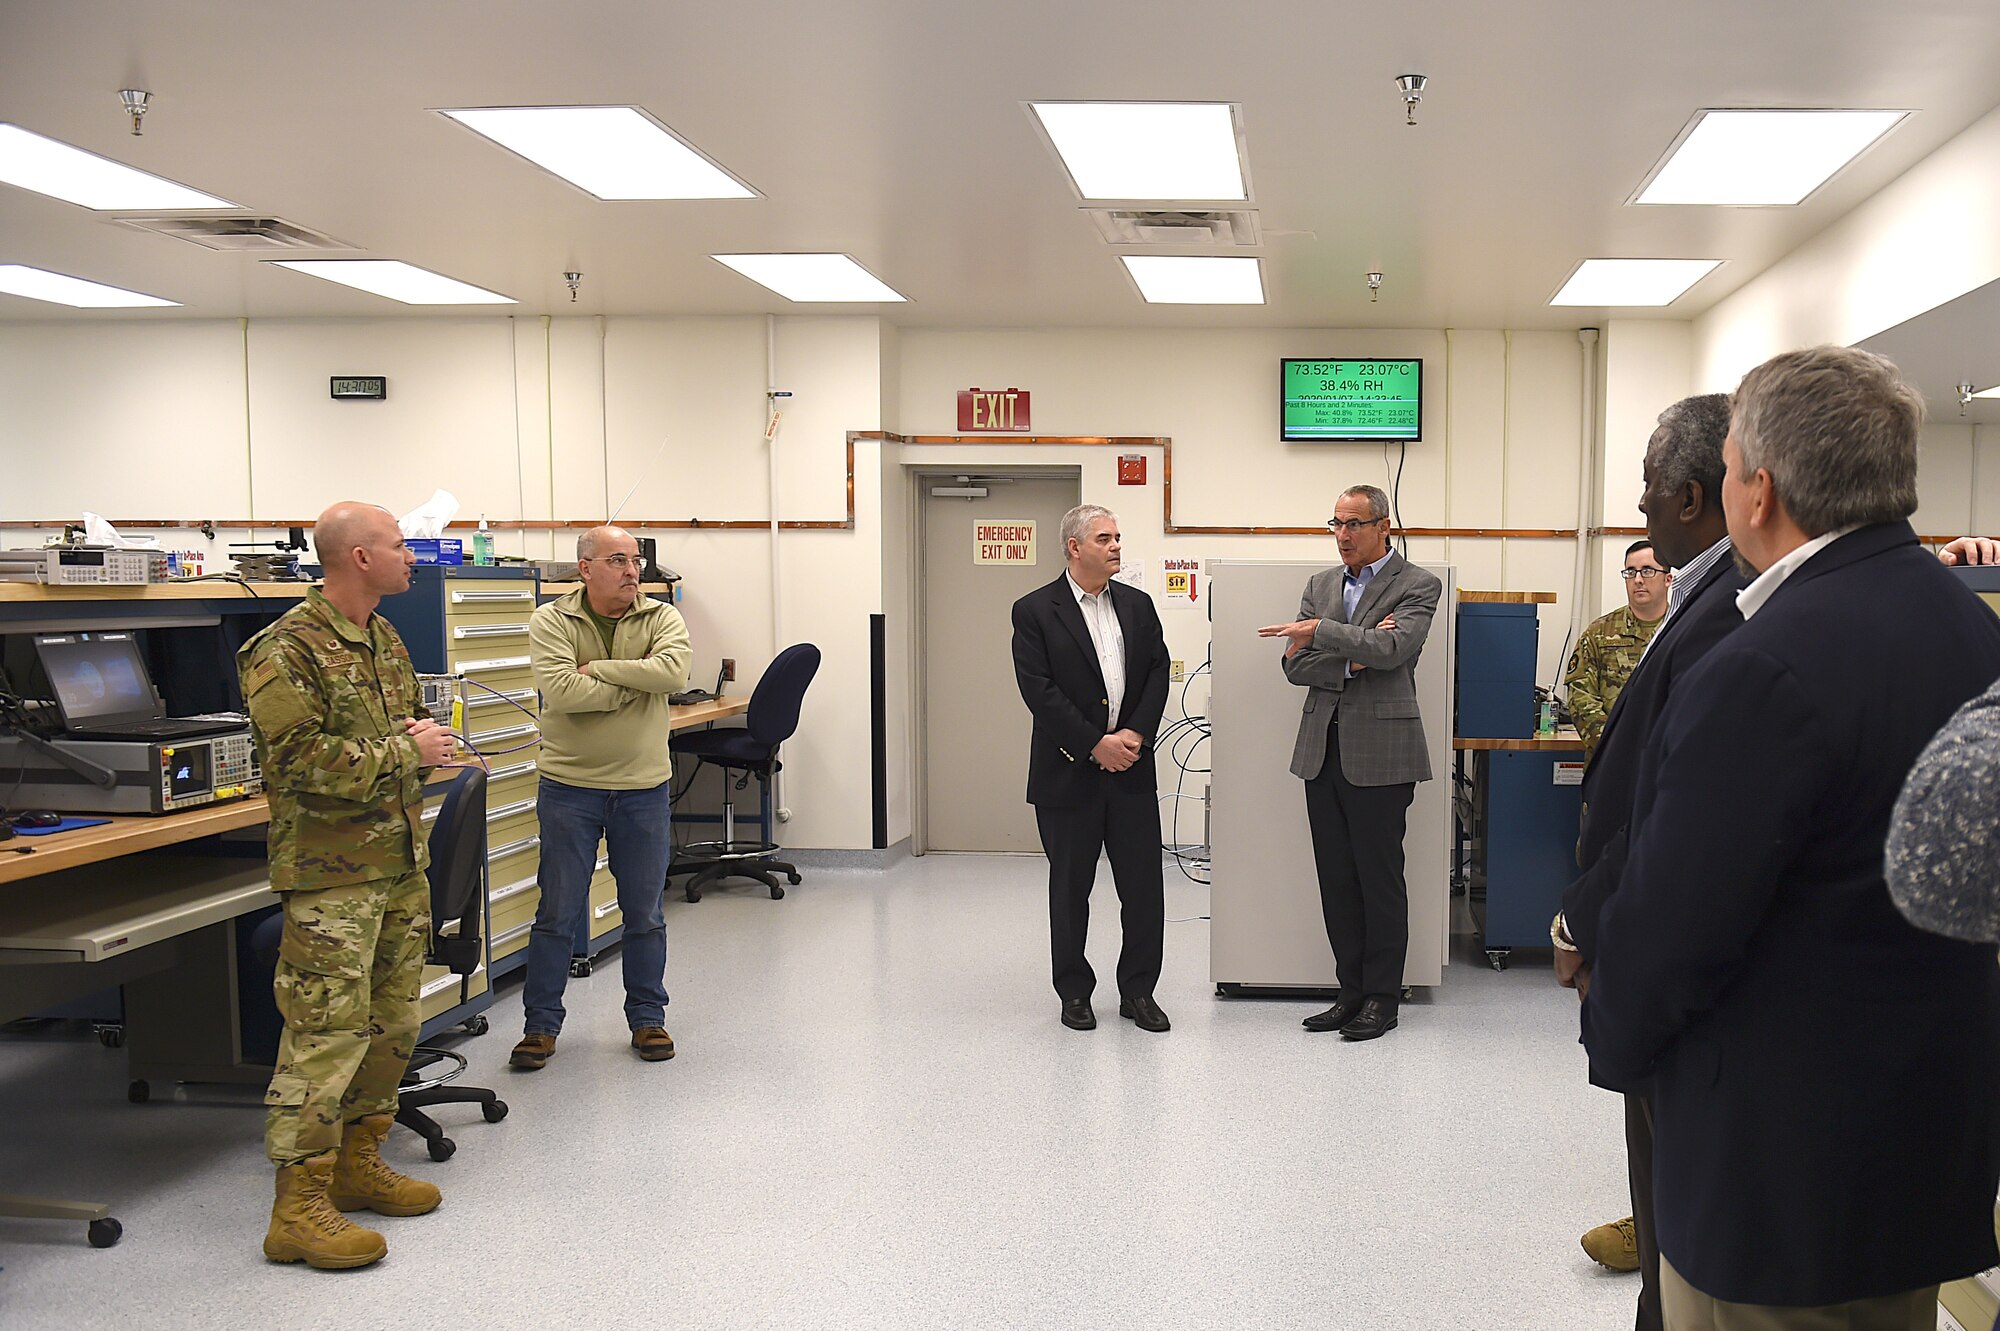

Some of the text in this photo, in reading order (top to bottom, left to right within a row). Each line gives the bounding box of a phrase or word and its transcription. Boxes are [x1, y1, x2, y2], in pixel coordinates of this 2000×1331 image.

[1294, 364, 1409, 375] 73.52°F 23.07°C
[1320, 380, 1383, 391] 38.4% RH
[972, 393, 1018, 428] EXIT
[977, 526, 1032, 541] EMERGENCY
[981, 545, 1028, 559] EXIT ONLY
